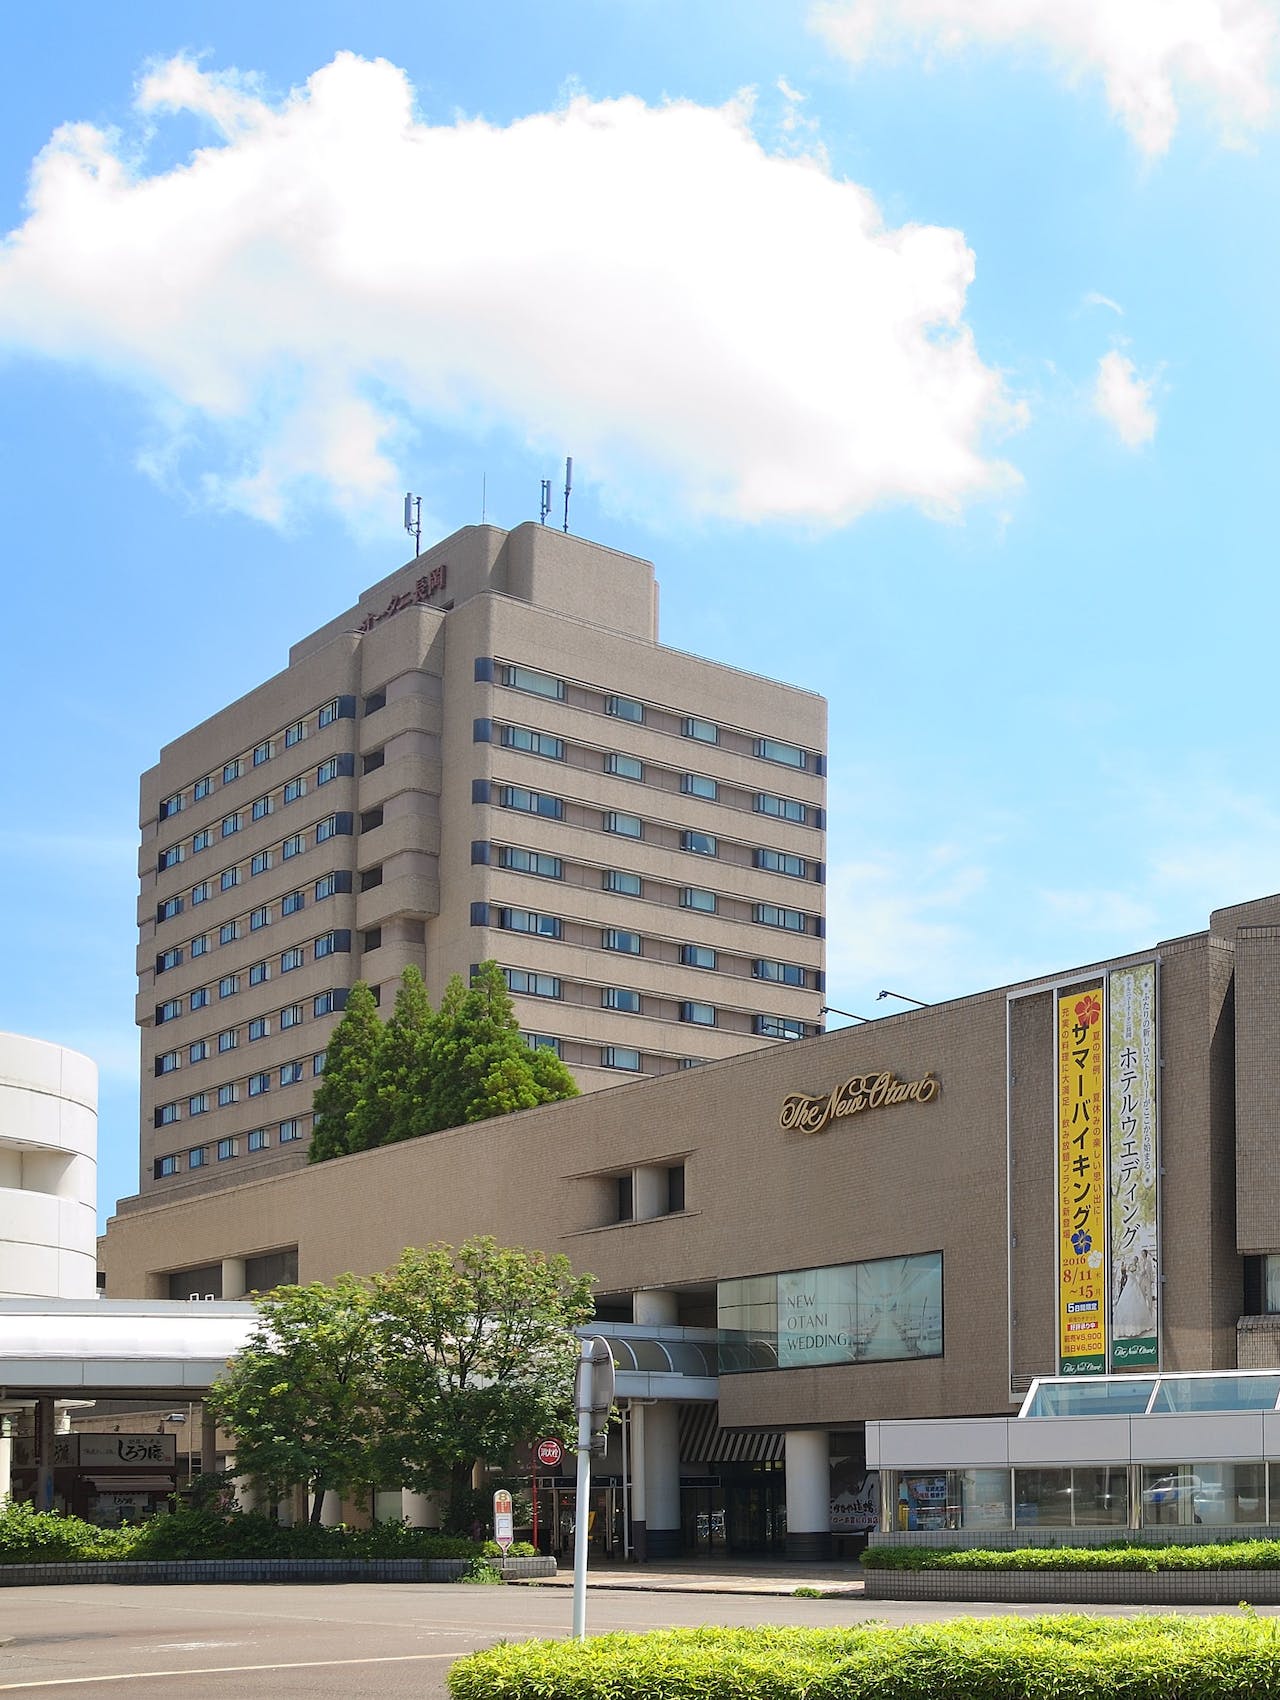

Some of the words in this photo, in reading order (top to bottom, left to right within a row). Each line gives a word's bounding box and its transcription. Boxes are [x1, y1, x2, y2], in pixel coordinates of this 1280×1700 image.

[862, 1071, 940, 1109] Otani
[780, 1092, 824, 1129] The
[800, 1075, 868, 1134] New
[1072, 1021, 1091, 1229] サマーバイキング
[1120, 1047, 1140, 1249] ホテルウエディング
[1063, 1255, 1086, 1266] 2016
[1063, 1267, 1091, 1285] 8/11
[787, 1294, 815, 1308] NEW
[787, 1313, 828, 1329] OTANI
[787, 1333, 847, 1350] WEDDING
[1114, 1347, 1129, 1358] The
[1063, 1363, 1077, 1374] The
[541, 1449, 559, 1458] 消火栓
